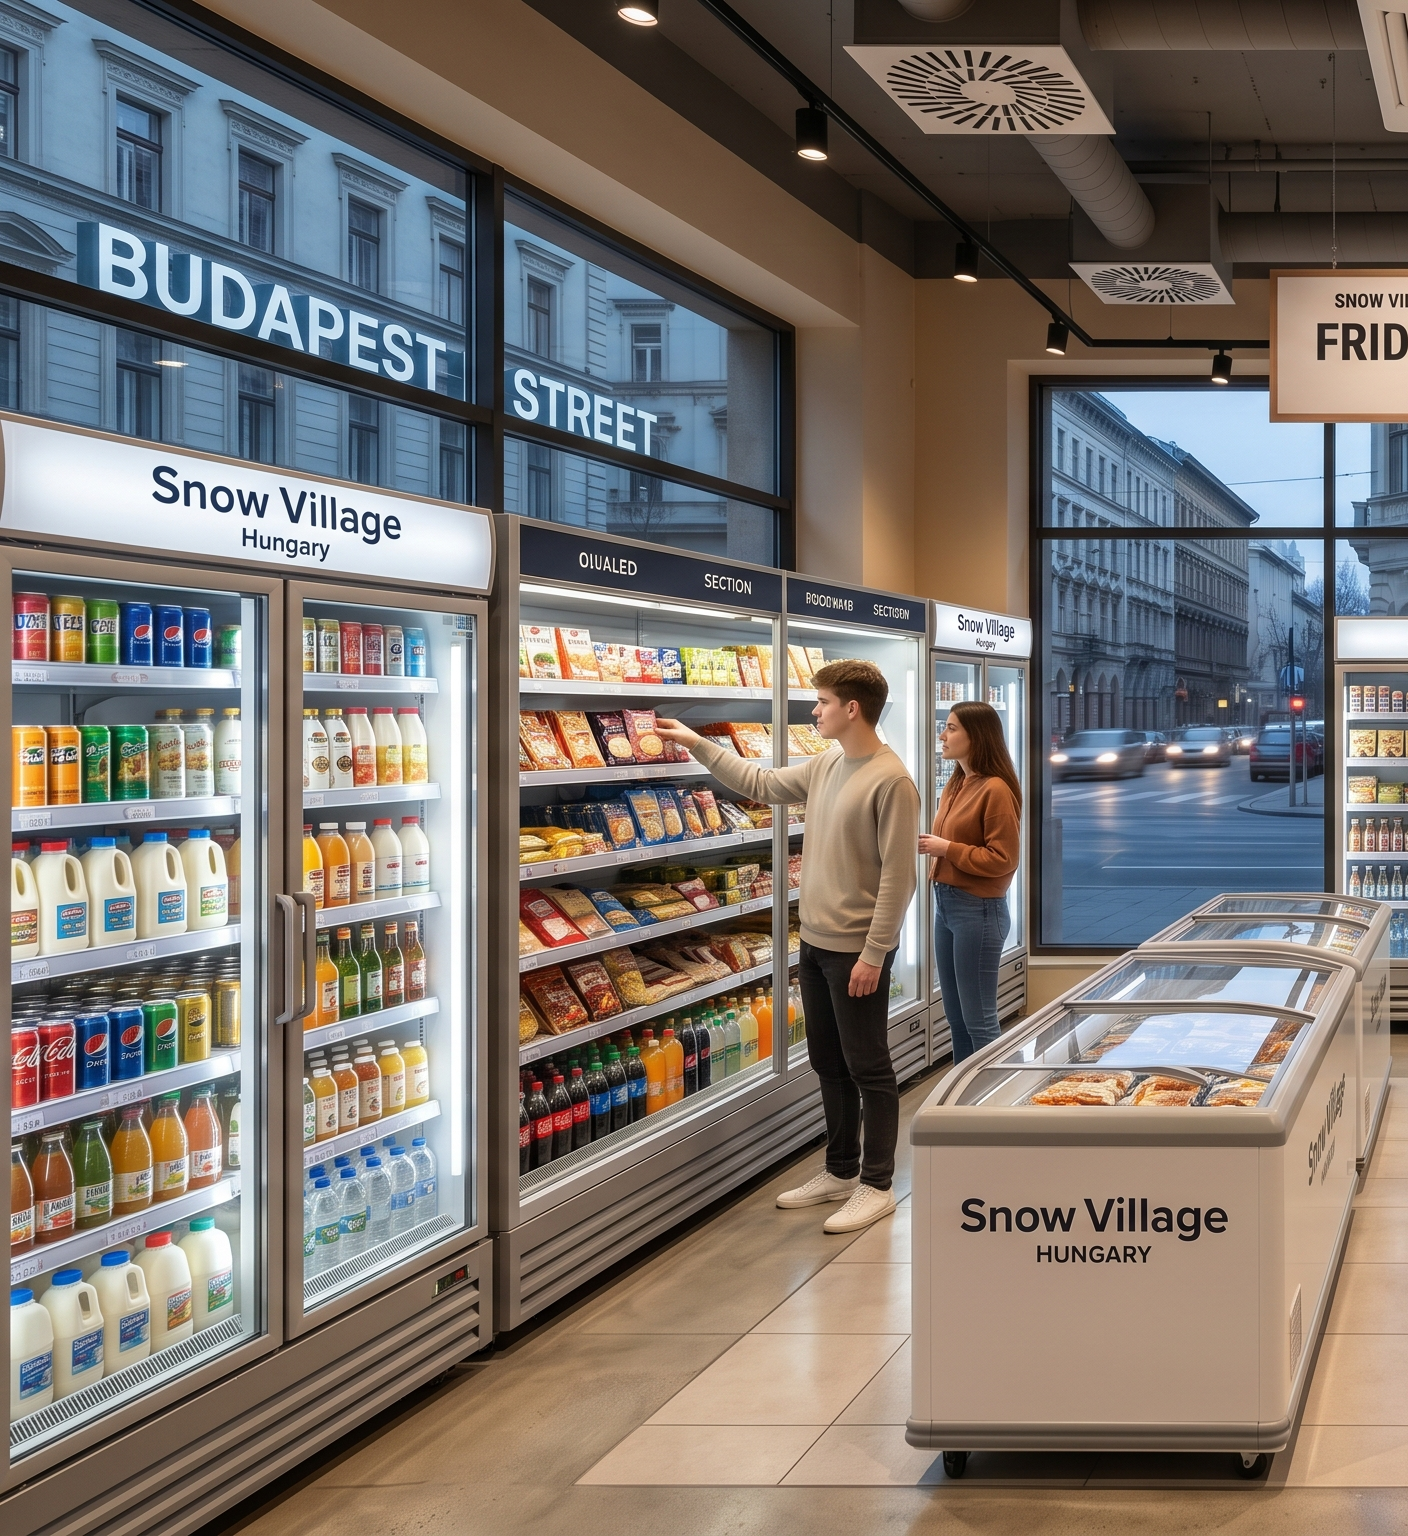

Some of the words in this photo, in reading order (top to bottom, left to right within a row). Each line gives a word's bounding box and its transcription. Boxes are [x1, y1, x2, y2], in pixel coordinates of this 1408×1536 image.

[1334, 293, 1384, 309] SNOW
[98, 222, 447, 391] BUDAPEST
[513, 368, 658, 456] STREET
[152, 465, 270, 519] Snow
[279, 487, 402, 545] Village
[242, 527, 331, 563] Hungary
[704, 573, 752, 595] SECTION
[958, 613, 984, 633] Snow
[985, 618, 1015, 643] Village
[961, 1197, 1077, 1233] Snow
[1083, 1196, 1229, 1242] Village
[1036, 1245, 1152, 1264] HUNGARY
